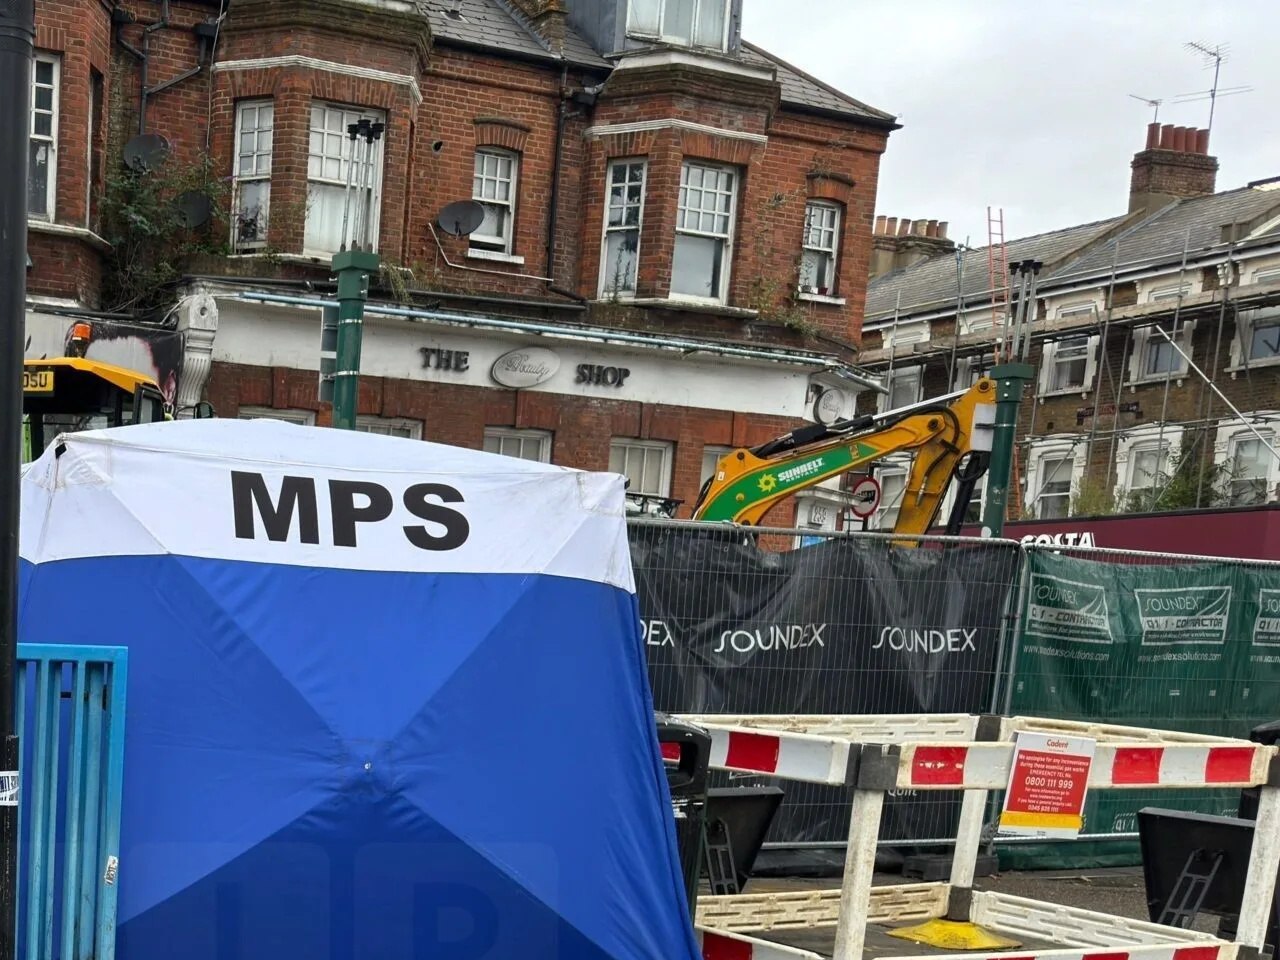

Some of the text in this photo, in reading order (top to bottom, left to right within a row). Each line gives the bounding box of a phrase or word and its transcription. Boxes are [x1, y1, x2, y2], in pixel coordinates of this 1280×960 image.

[419, 346, 470, 372] THE
[574, 362, 631, 388] SHOP
[777, 457, 823, 482] SUNBELT
[230, 470, 470, 551] MPS
[1144, 596, 1199, 612] SOUNDEX
[714, 622, 827, 653] SOUNDEX
[872, 626, 978, 654] SOUNDEX
[1046, 739, 1069, 748] Cadent
[1025, 776, 1074, 790] 0800 111 999
[1030, 769, 1056, 777] EMERGENCY
